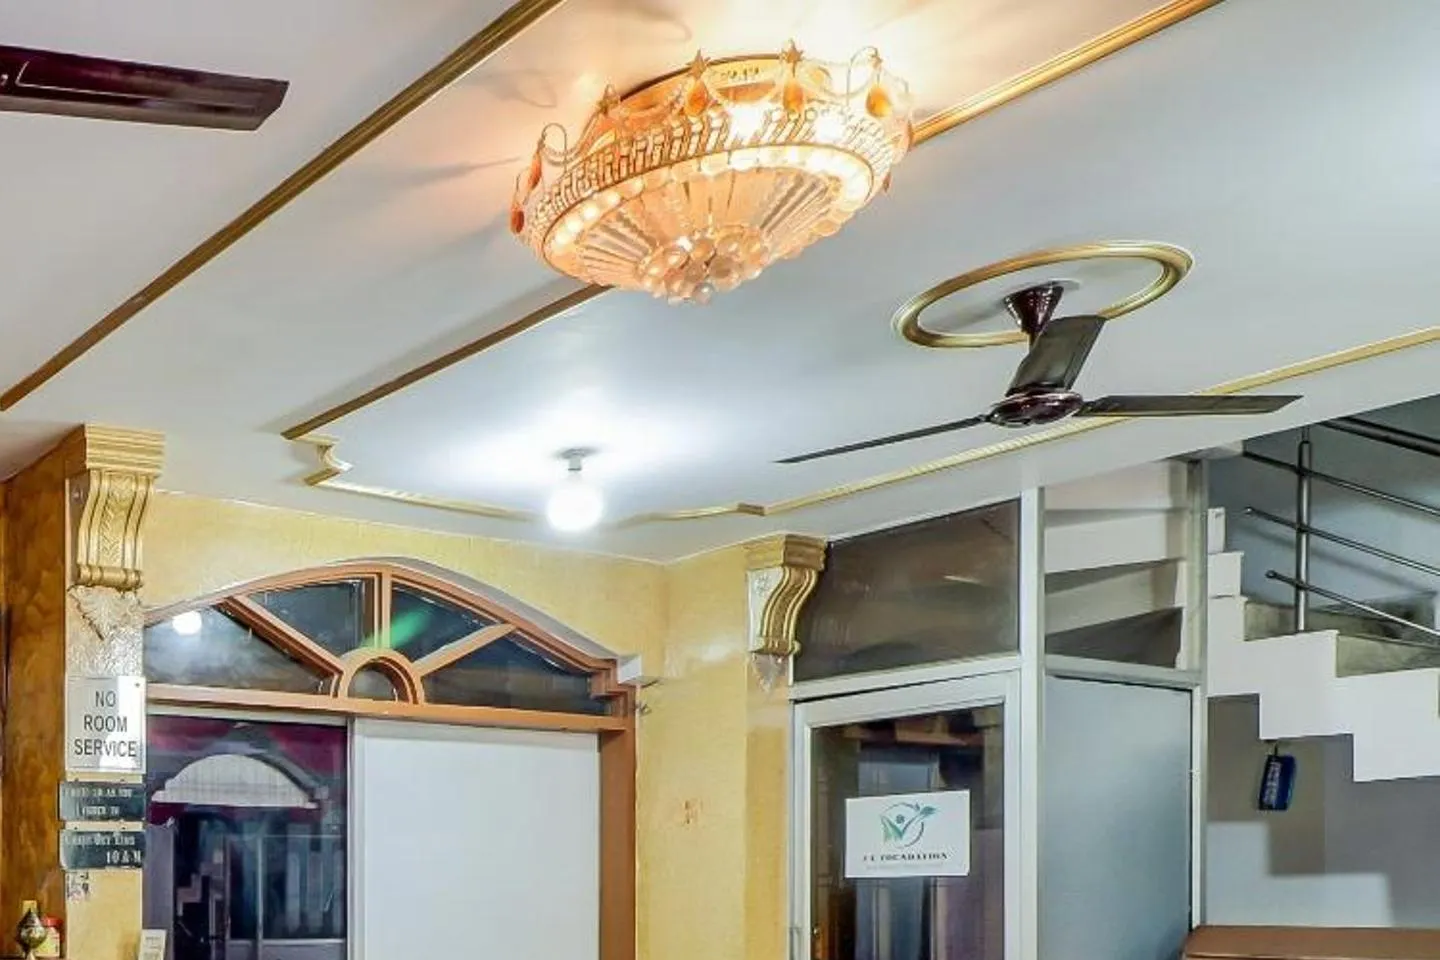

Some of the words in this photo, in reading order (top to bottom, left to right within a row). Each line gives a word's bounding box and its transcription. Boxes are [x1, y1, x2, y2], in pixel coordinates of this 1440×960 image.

[95, 690, 117, 708] NO
[83, 715, 128, 733] ROOM
[74, 738, 138, 758] SERVICE
